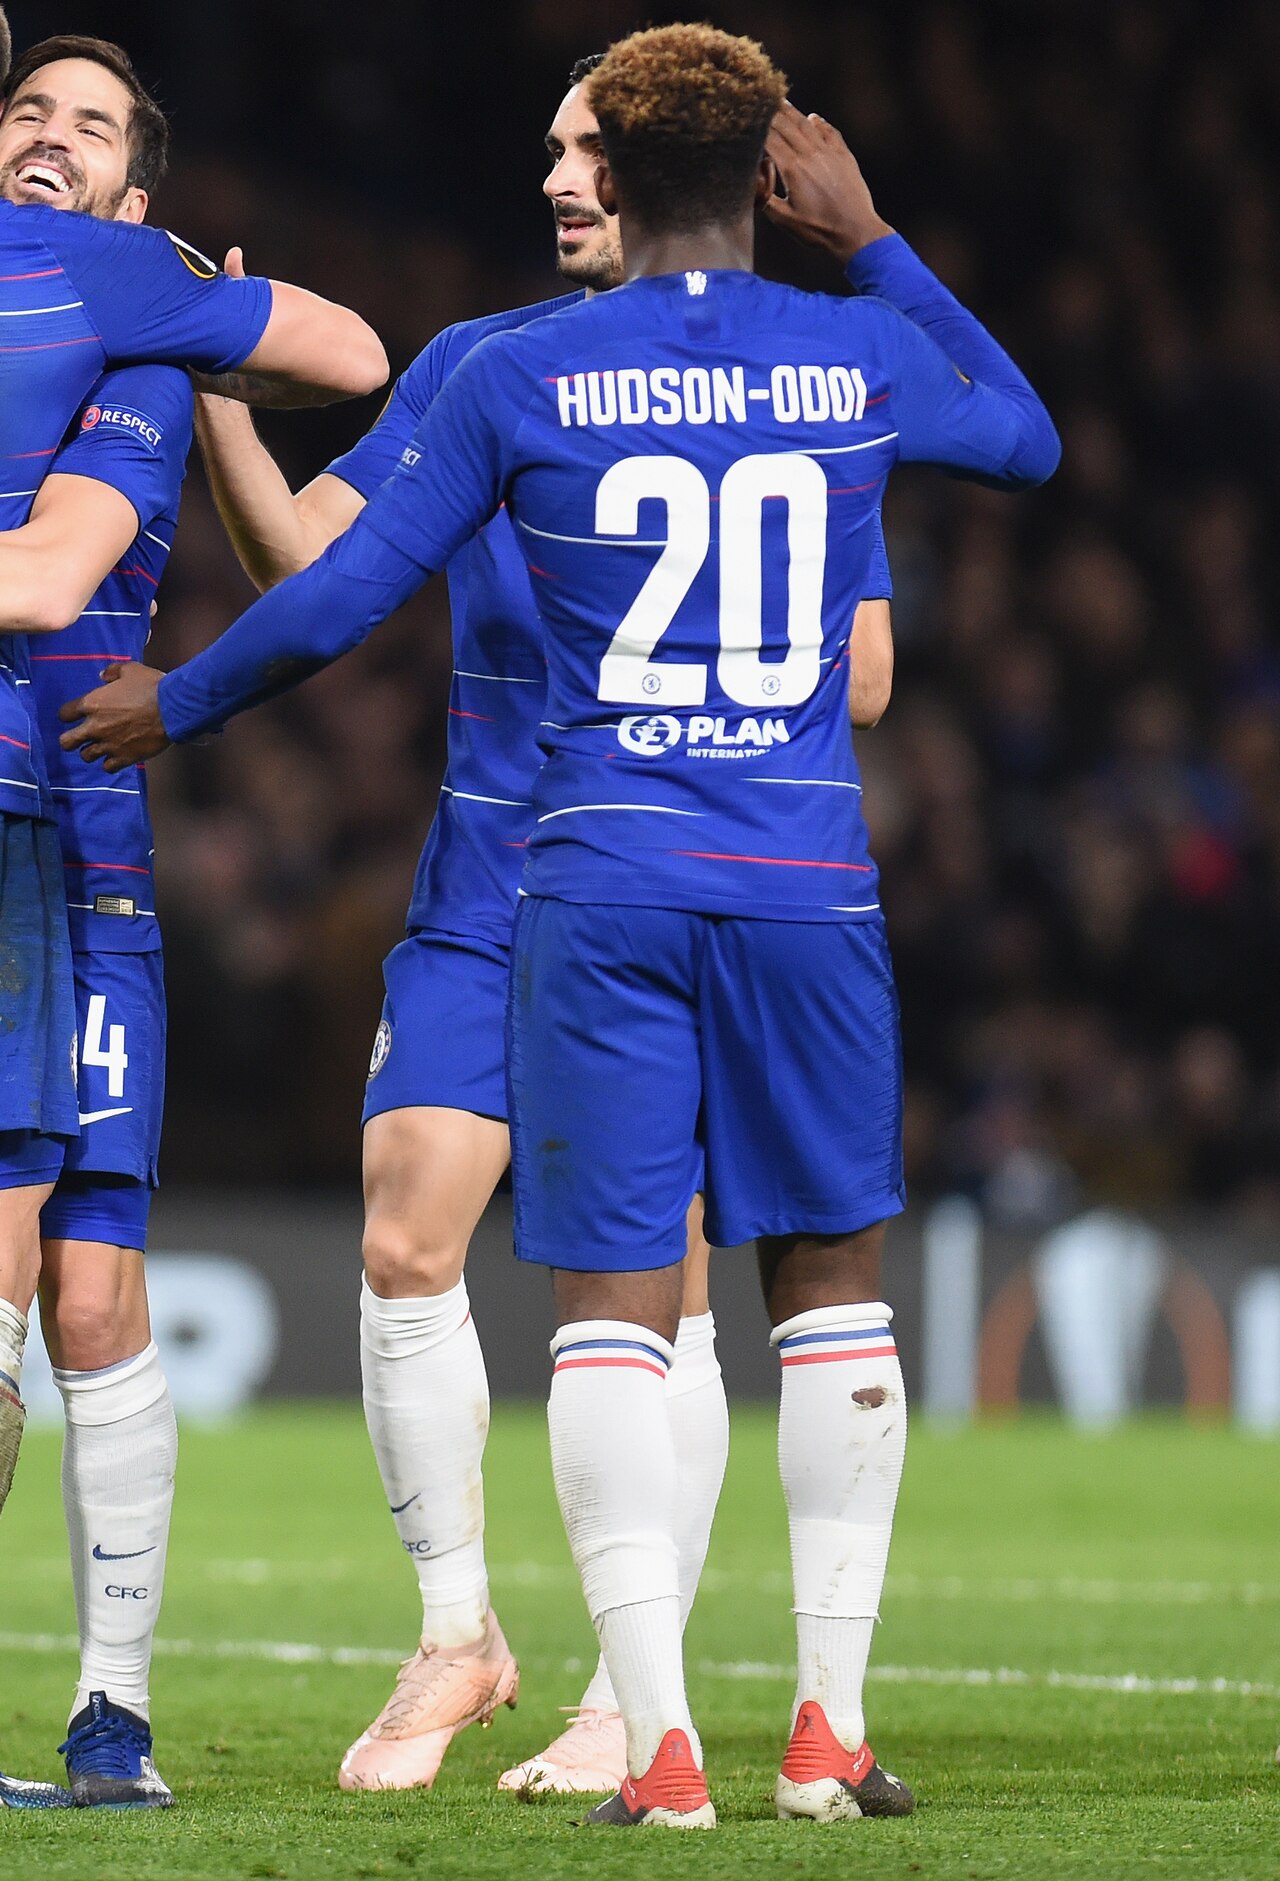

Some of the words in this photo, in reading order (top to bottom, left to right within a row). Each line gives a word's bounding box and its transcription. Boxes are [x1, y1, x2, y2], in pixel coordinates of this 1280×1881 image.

[556, 364, 868, 428] HUDSON-ODOI
[100, 410, 161, 446] RESPECT
[594, 453, 828, 707] 20
[687, 715, 791, 746] PLAN
[82, 994, 129, 1098] 4
[104, 1584, 149, 1600] CFC
